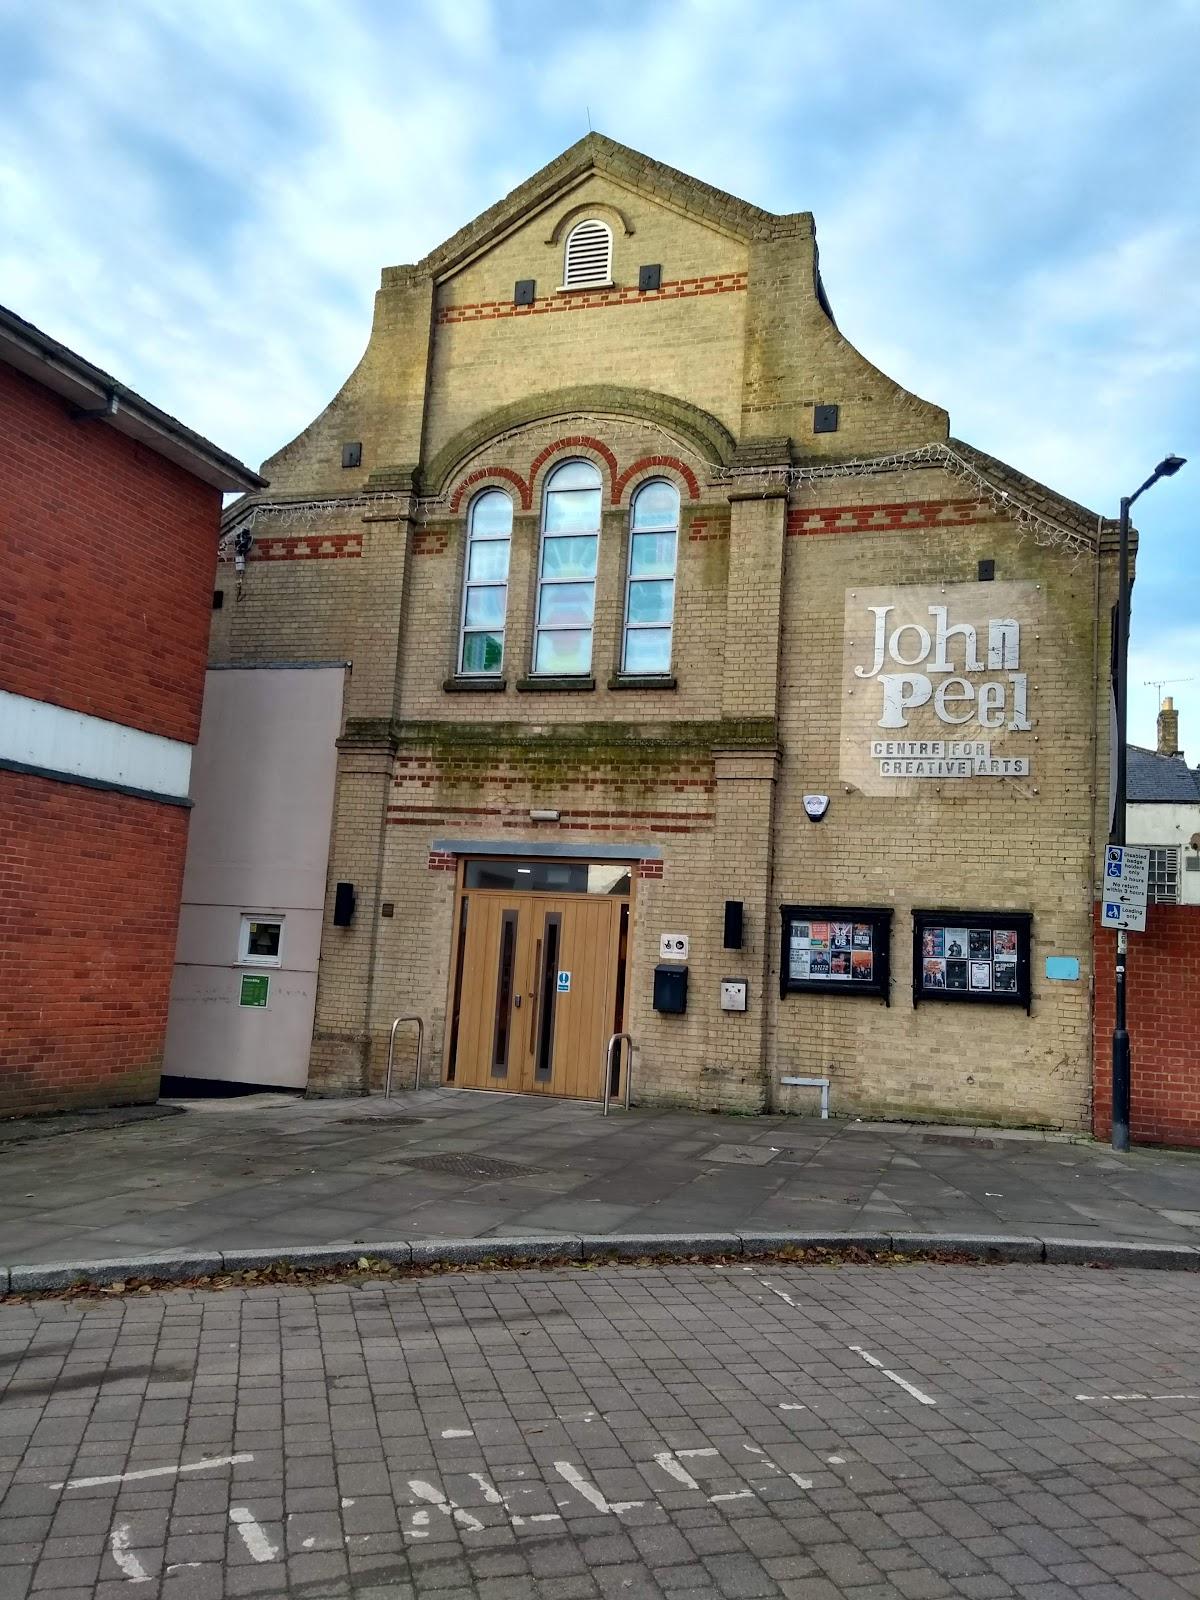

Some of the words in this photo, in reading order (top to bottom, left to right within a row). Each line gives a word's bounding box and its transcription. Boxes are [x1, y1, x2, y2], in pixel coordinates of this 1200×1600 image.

[854, 605, 1020, 678] John
[877, 672, 1032, 731] Peel
[873, 742, 940, 755] CENTRE
[951, 743, 985, 756] FOR
[881, 760, 967, 775] CREATIVE
[977, 759, 1023, 773] ARTS
